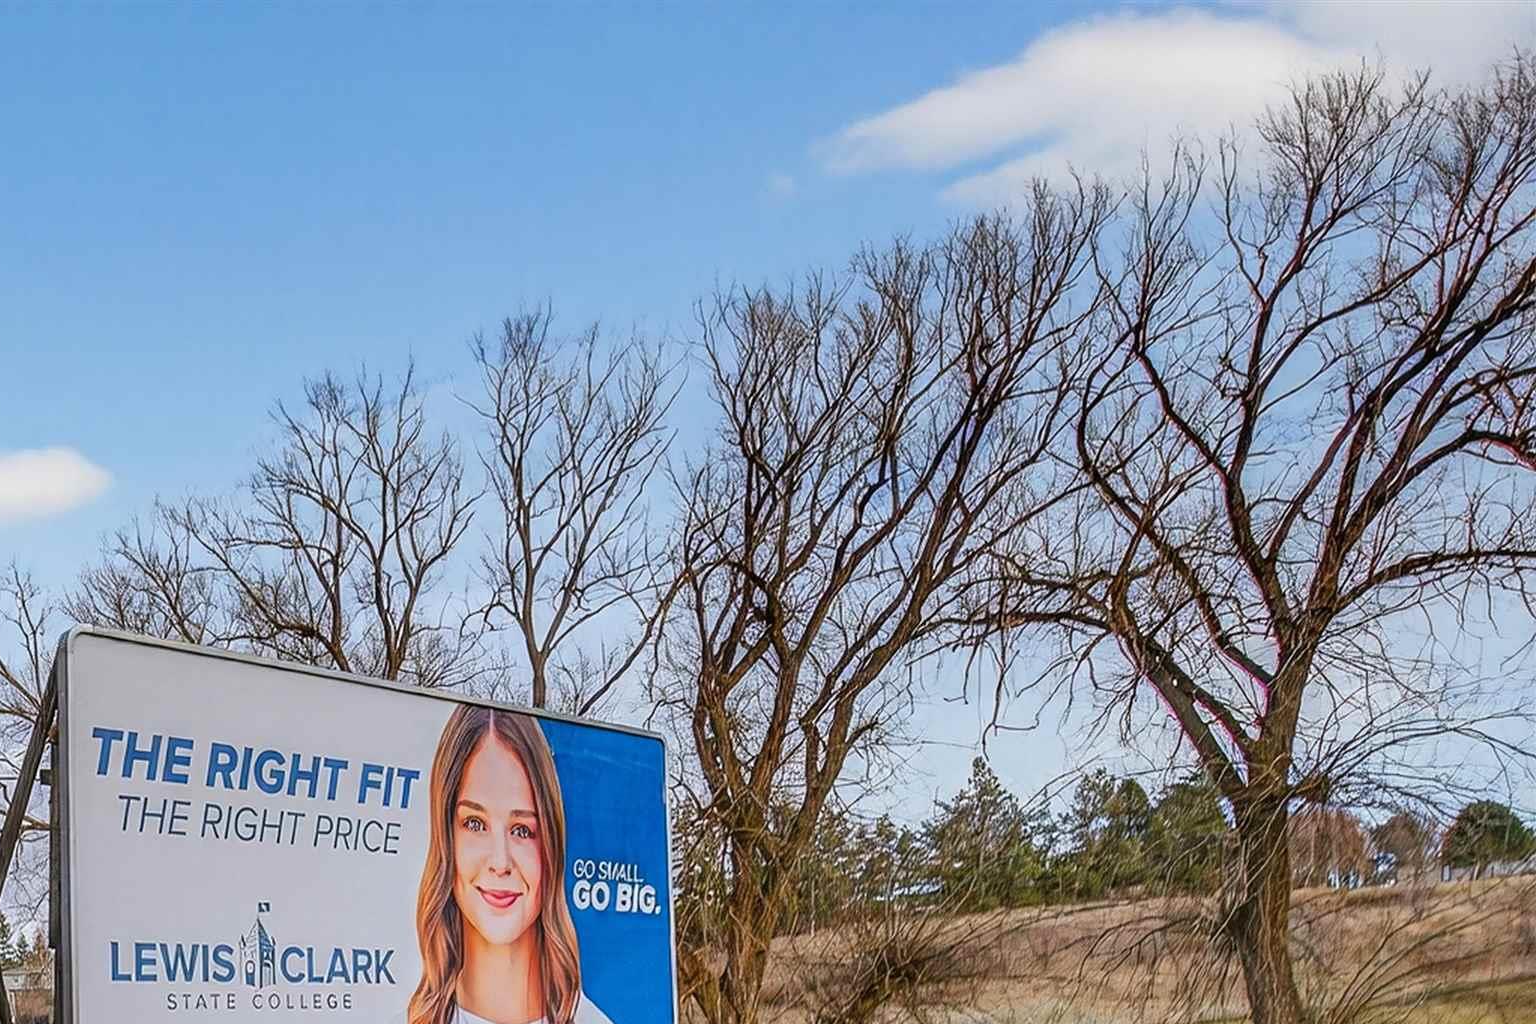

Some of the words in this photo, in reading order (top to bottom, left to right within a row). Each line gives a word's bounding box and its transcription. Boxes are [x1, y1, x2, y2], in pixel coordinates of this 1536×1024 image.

[92, 727, 194, 785] THE
[205, 742, 349, 801] RIGHT
[357, 763, 420, 808] FIT
[118, 795, 191, 836] THE
[201, 803, 306, 845] RIGHT
[313, 815, 401, 854] PRICE
[573, 859, 595, 879] GO
[573, 880, 610, 911] GO
[616, 882, 661, 914] BIG.
[110, 941, 236, 983] LEWIS
[280, 946, 396, 985] CLARK
[167, 993, 236, 1010] STATE
[252, 993, 352, 1010] COLLEGE
